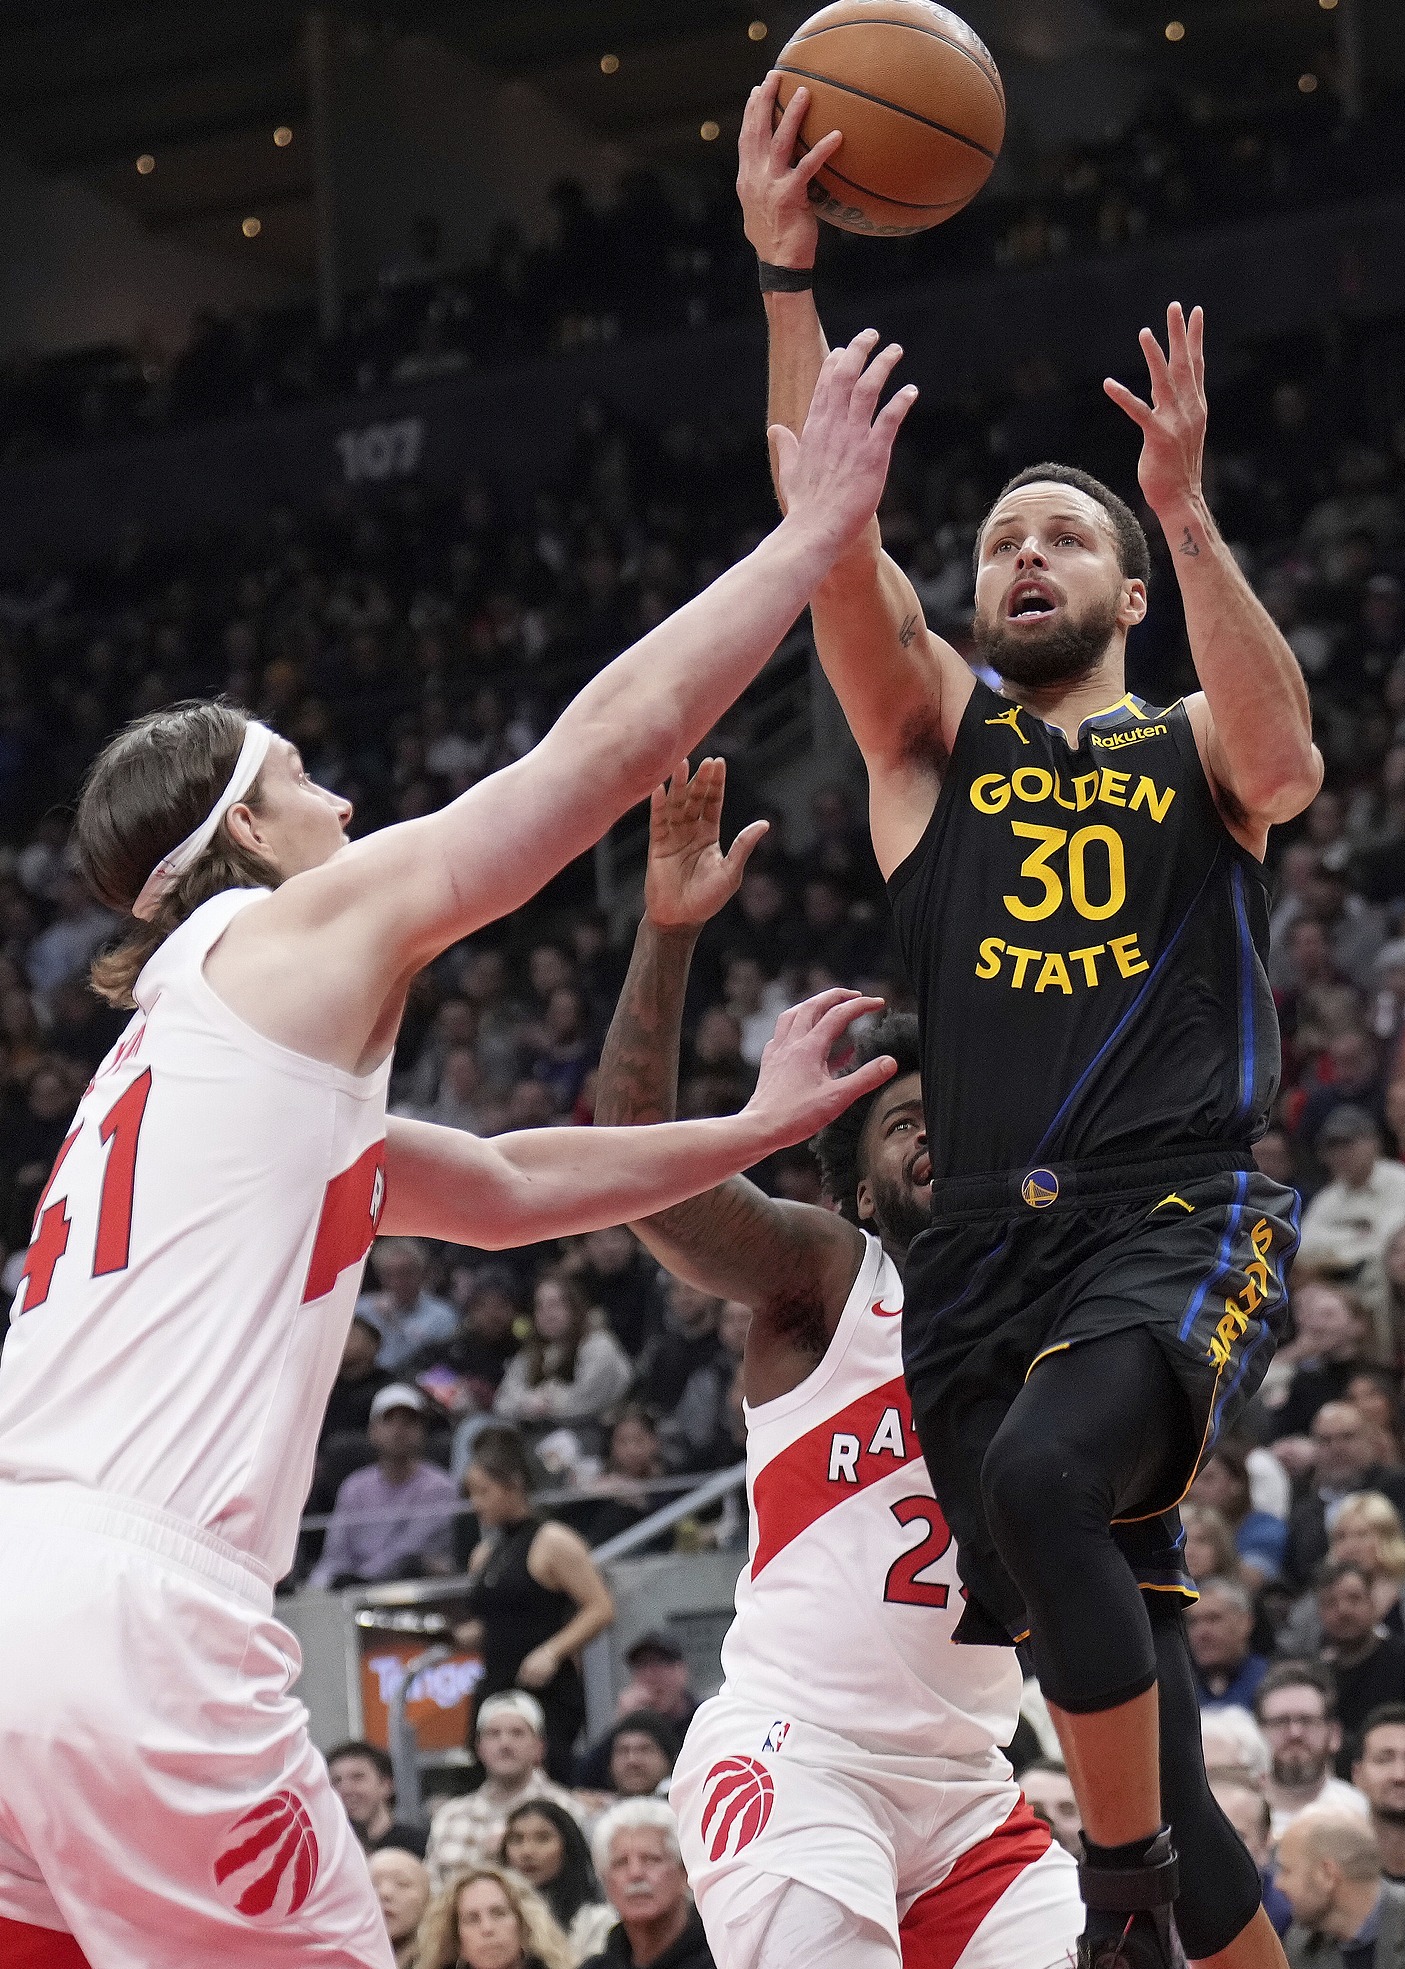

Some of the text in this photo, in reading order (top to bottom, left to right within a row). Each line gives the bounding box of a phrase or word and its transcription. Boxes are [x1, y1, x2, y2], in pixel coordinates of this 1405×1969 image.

[335, 419, 422, 480] 107
[1091, 724, 1168, 749] Rakuten
[969, 766, 1176, 824] GOLDEN
[1002, 820, 1126, 922] 30
[975, 932, 1150, 995] STATE
[19, 1065, 152, 1317] 41
[827, 1406, 917, 1483] RA
[882, 1495, 969, 1610] 2
